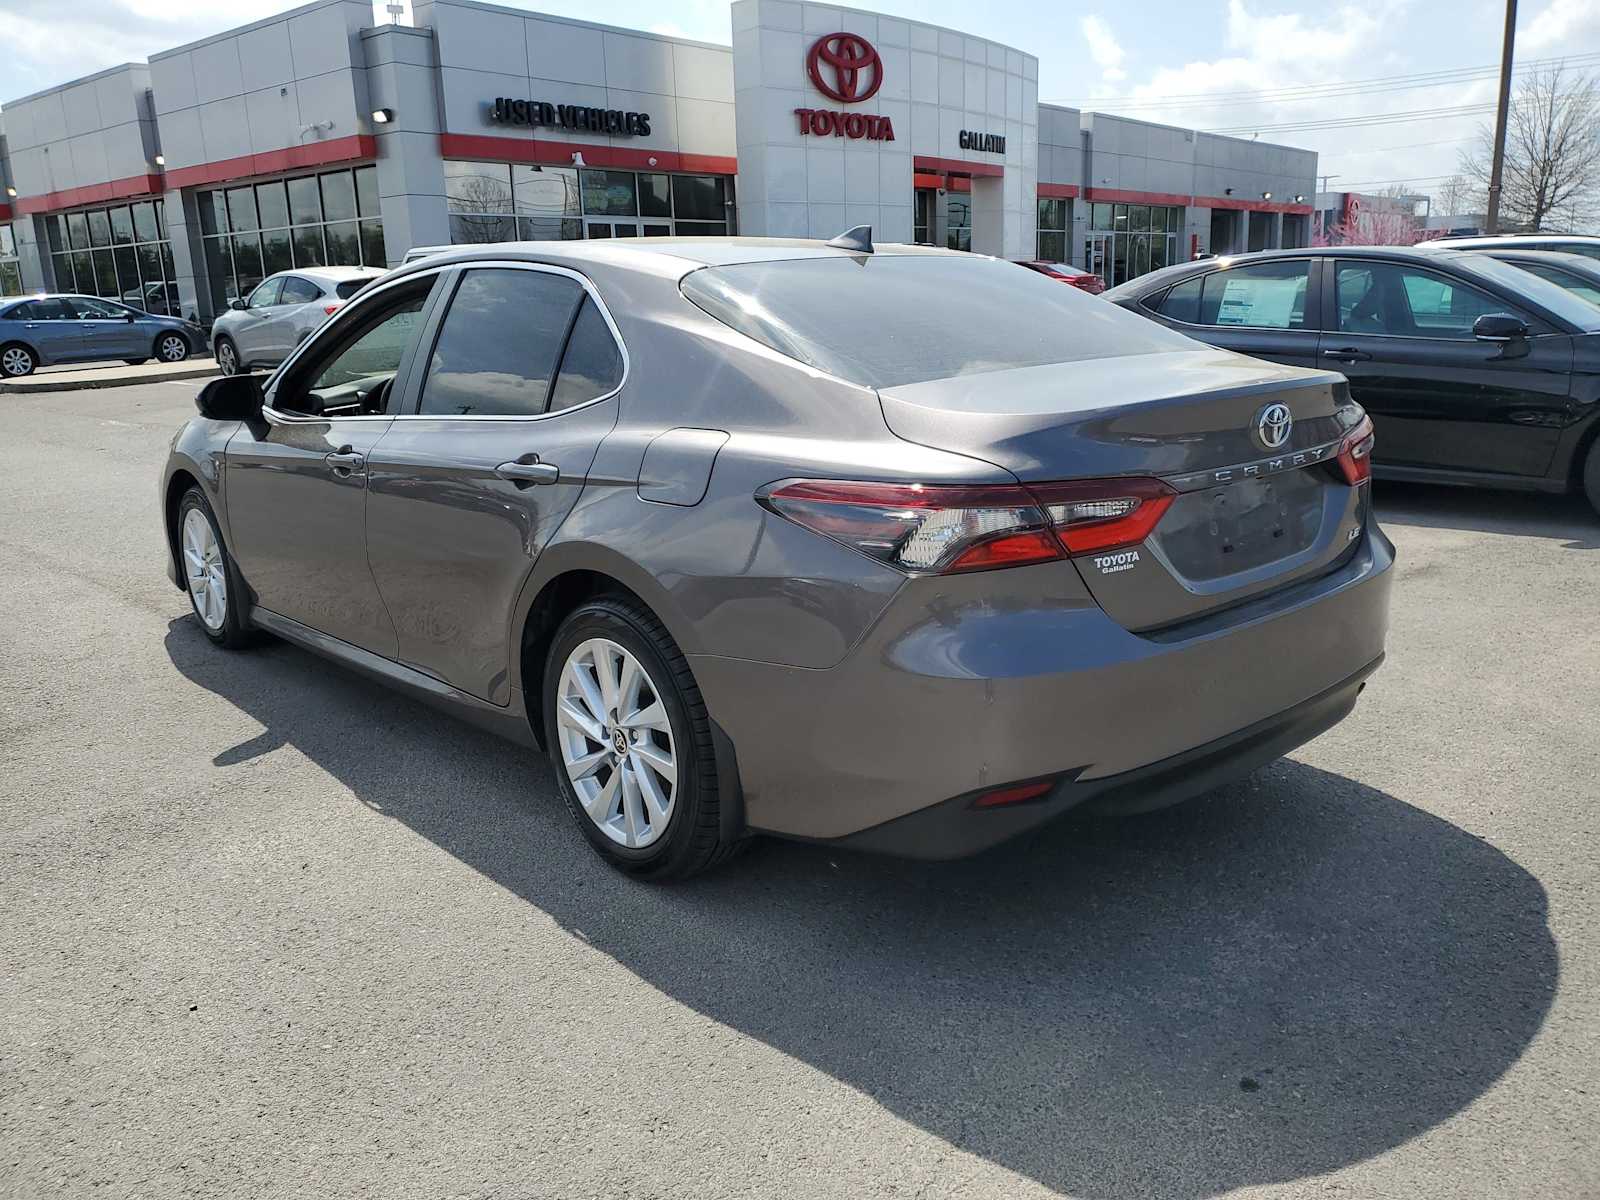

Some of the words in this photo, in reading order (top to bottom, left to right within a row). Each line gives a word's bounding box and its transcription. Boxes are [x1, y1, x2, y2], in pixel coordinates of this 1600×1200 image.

[495, 97, 556, 129] USED
[557, 104, 651, 136] VEHICLES
[794, 108, 895, 141] TOYOTA
[959, 129, 1006, 155] GALLATIN
[1215, 449, 1324, 481] CAMRY
[1094, 551, 1140, 569] TOYOTA
[1102, 563, 1134, 574] Gallatin
